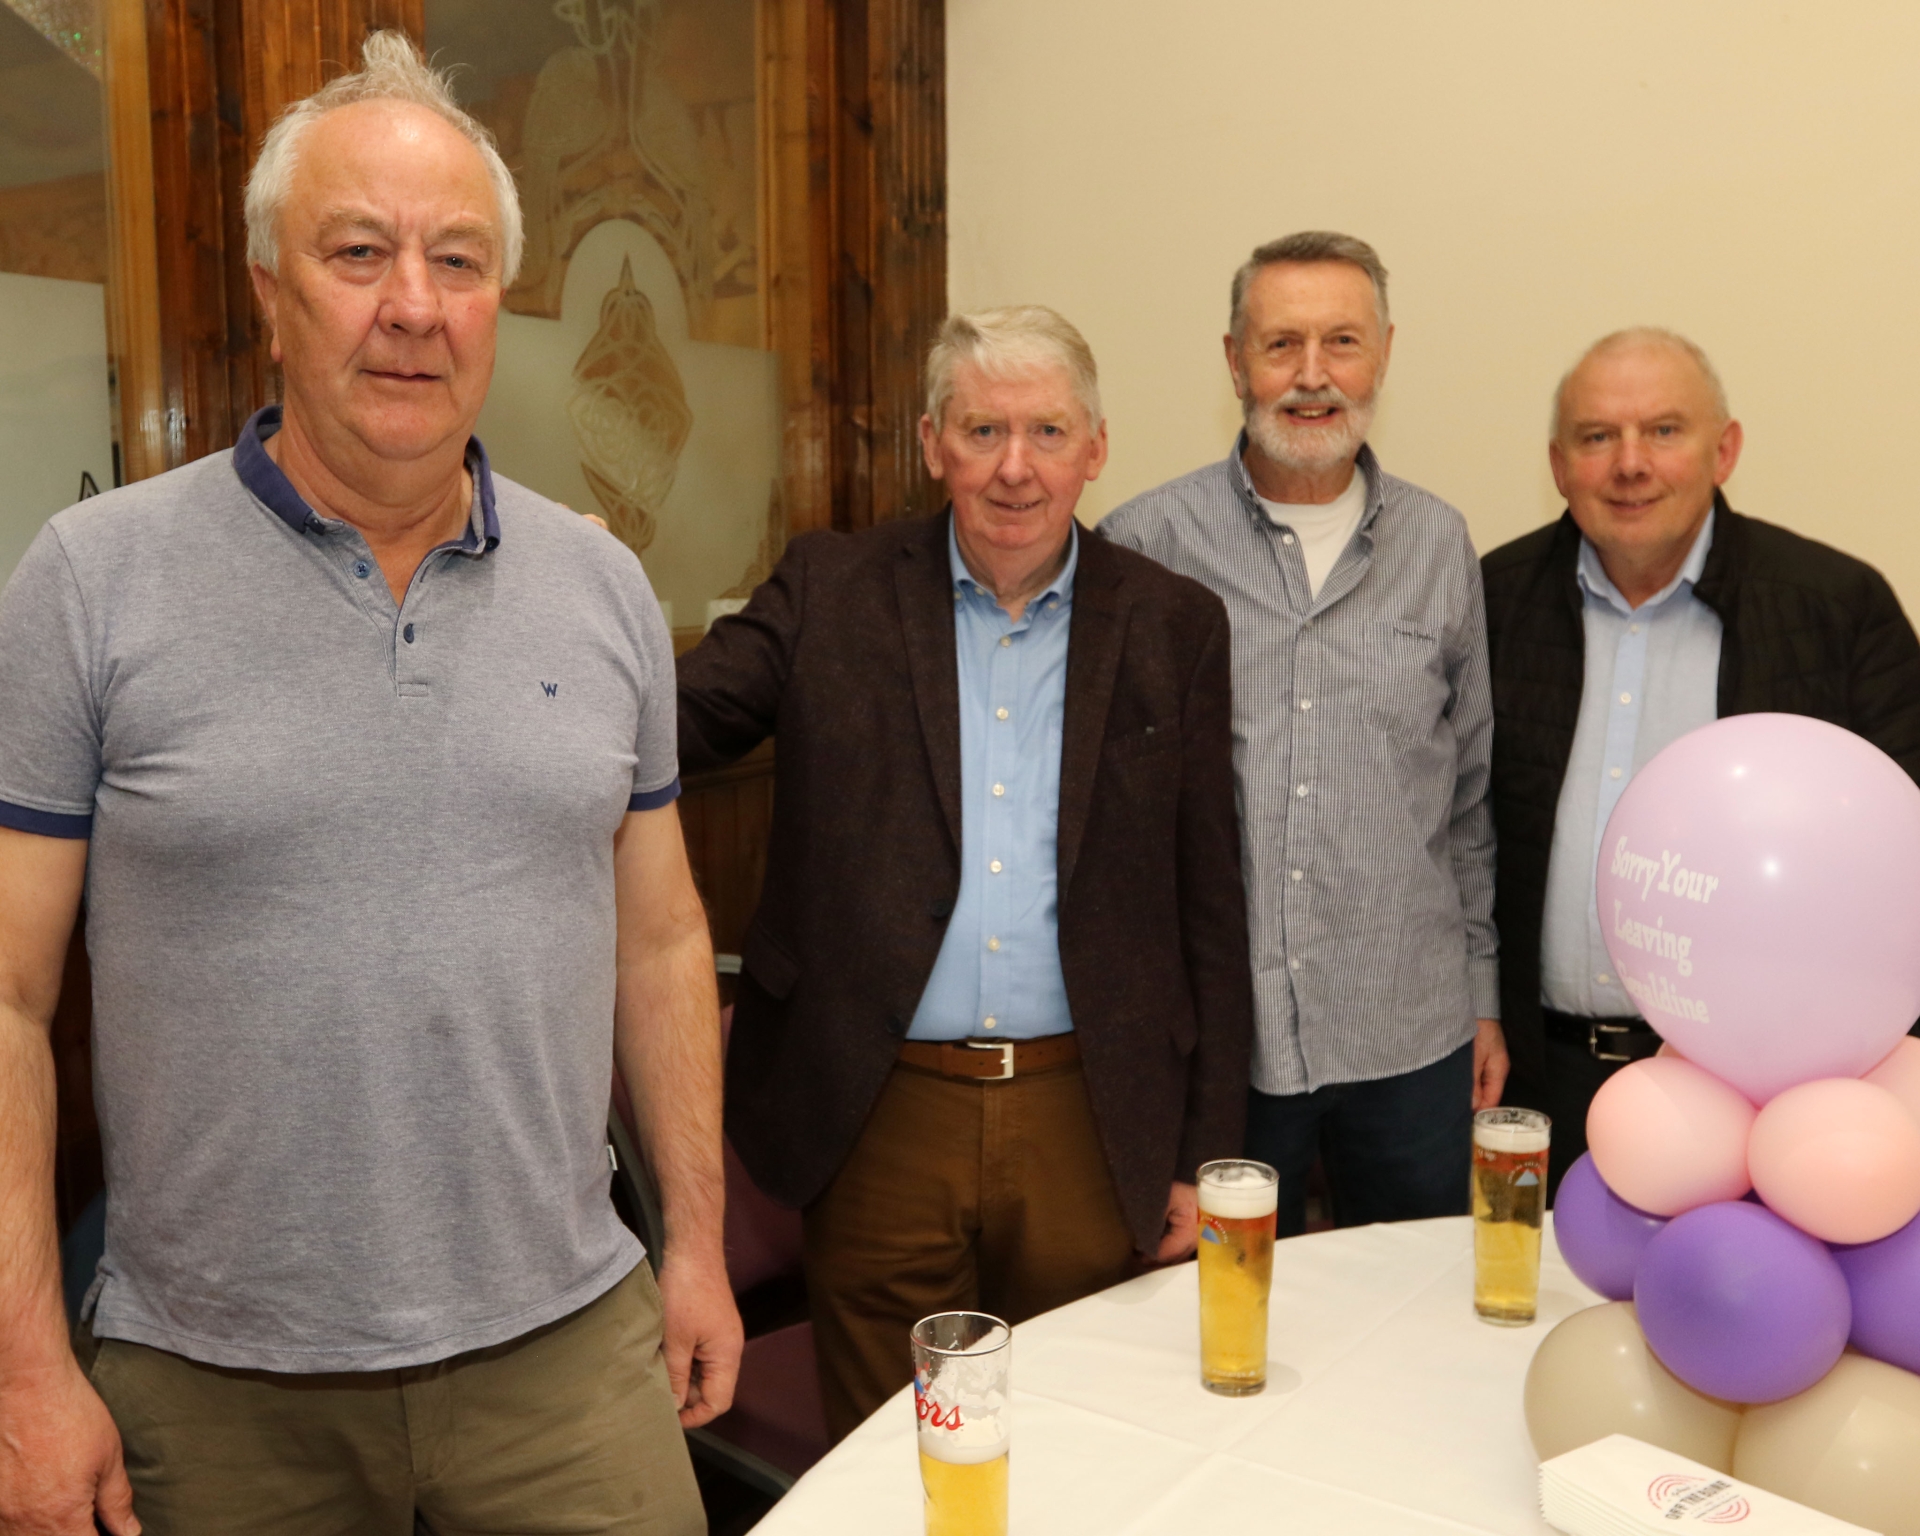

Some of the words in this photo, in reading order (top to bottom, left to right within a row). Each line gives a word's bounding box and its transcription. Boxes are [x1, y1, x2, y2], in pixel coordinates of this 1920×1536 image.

[541, 681, 558, 698] W
[1611, 836, 1660, 901] Sorry
[1657, 849, 1719, 904] Your
[1614, 899, 1694, 977] Leaving
[916, 1398, 964, 1431] ors
